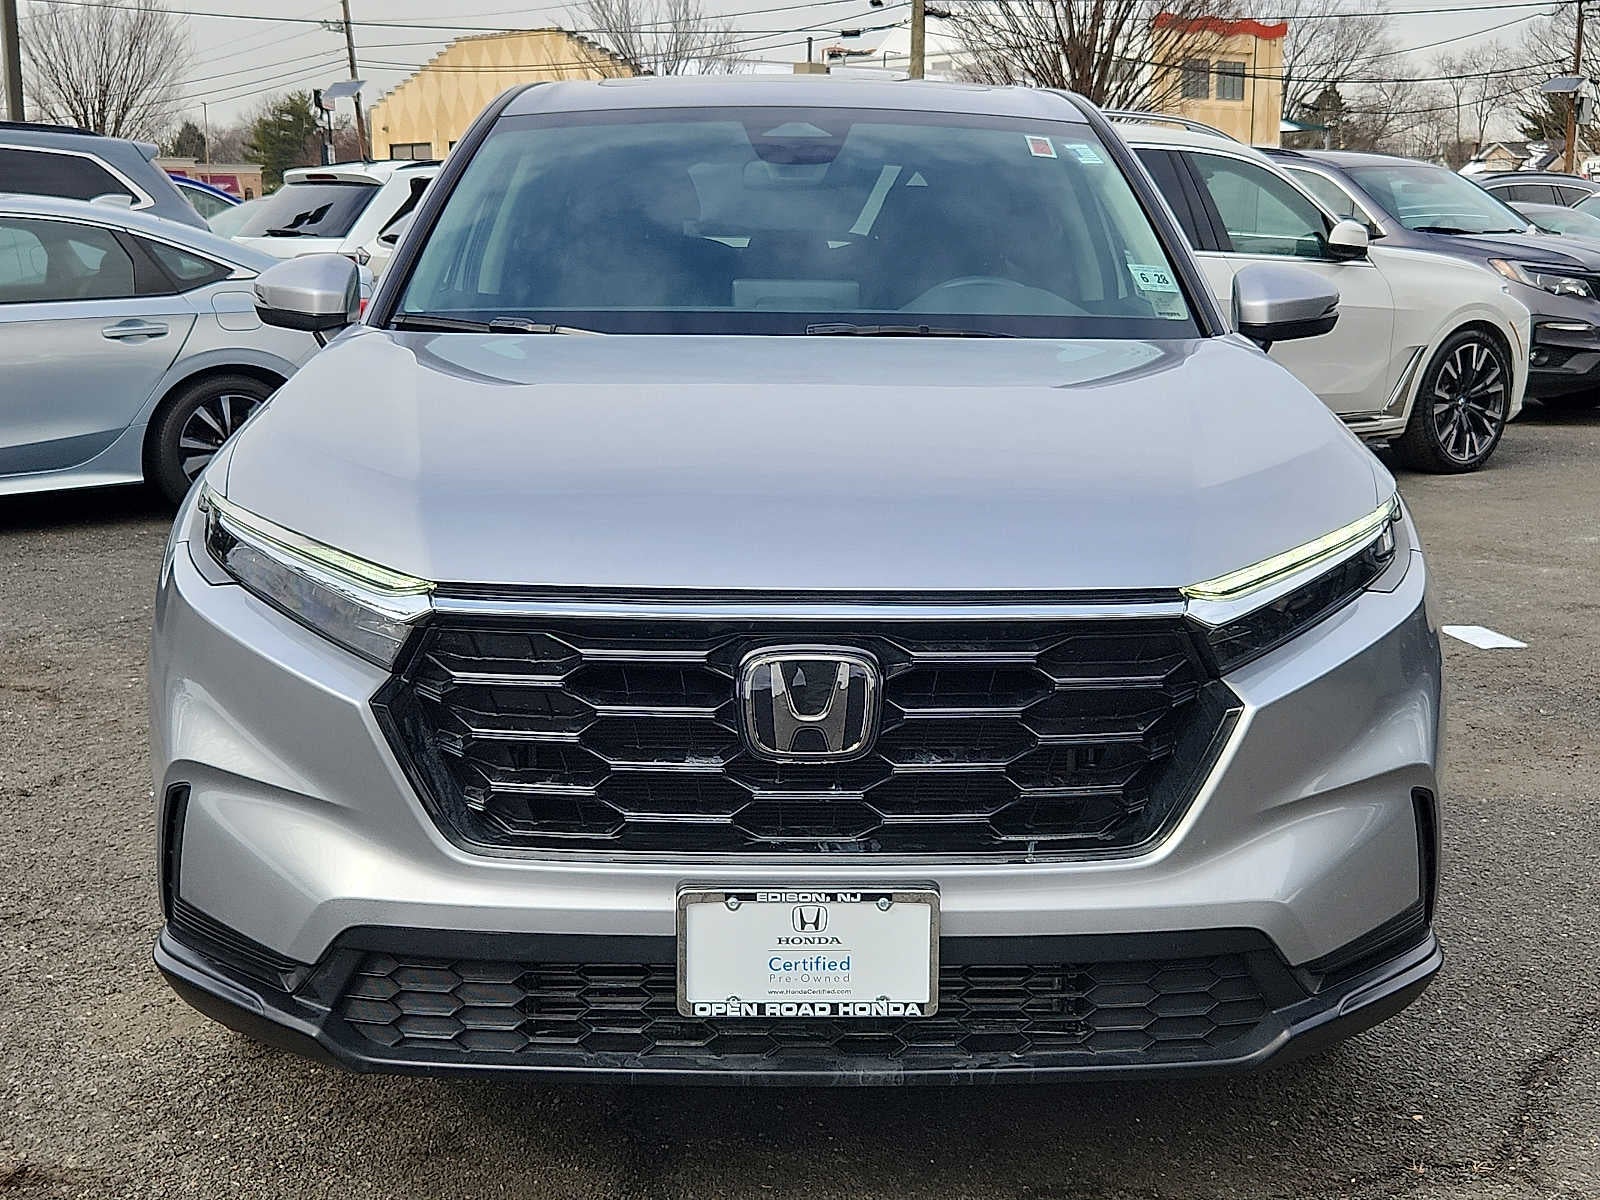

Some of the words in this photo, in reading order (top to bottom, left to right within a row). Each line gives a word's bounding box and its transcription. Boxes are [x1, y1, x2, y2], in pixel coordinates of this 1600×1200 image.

[1140, 273, 1149, 283] 6
[1154, 273, 1169, 284] 28
[756, 892, 831, 903] EDISON,
[837, 892, 861, 903] NJ
[777, 936, 842, 945] HONDA
[768, 955, 850, 971] Certified
[769, 973, 850, 983] Pre-Owned
[694, 1003, 757, 1016] OPEN
[765, 1003, 831, 1016] ROAD
[839, 1003, 922, 1016] HONDA
